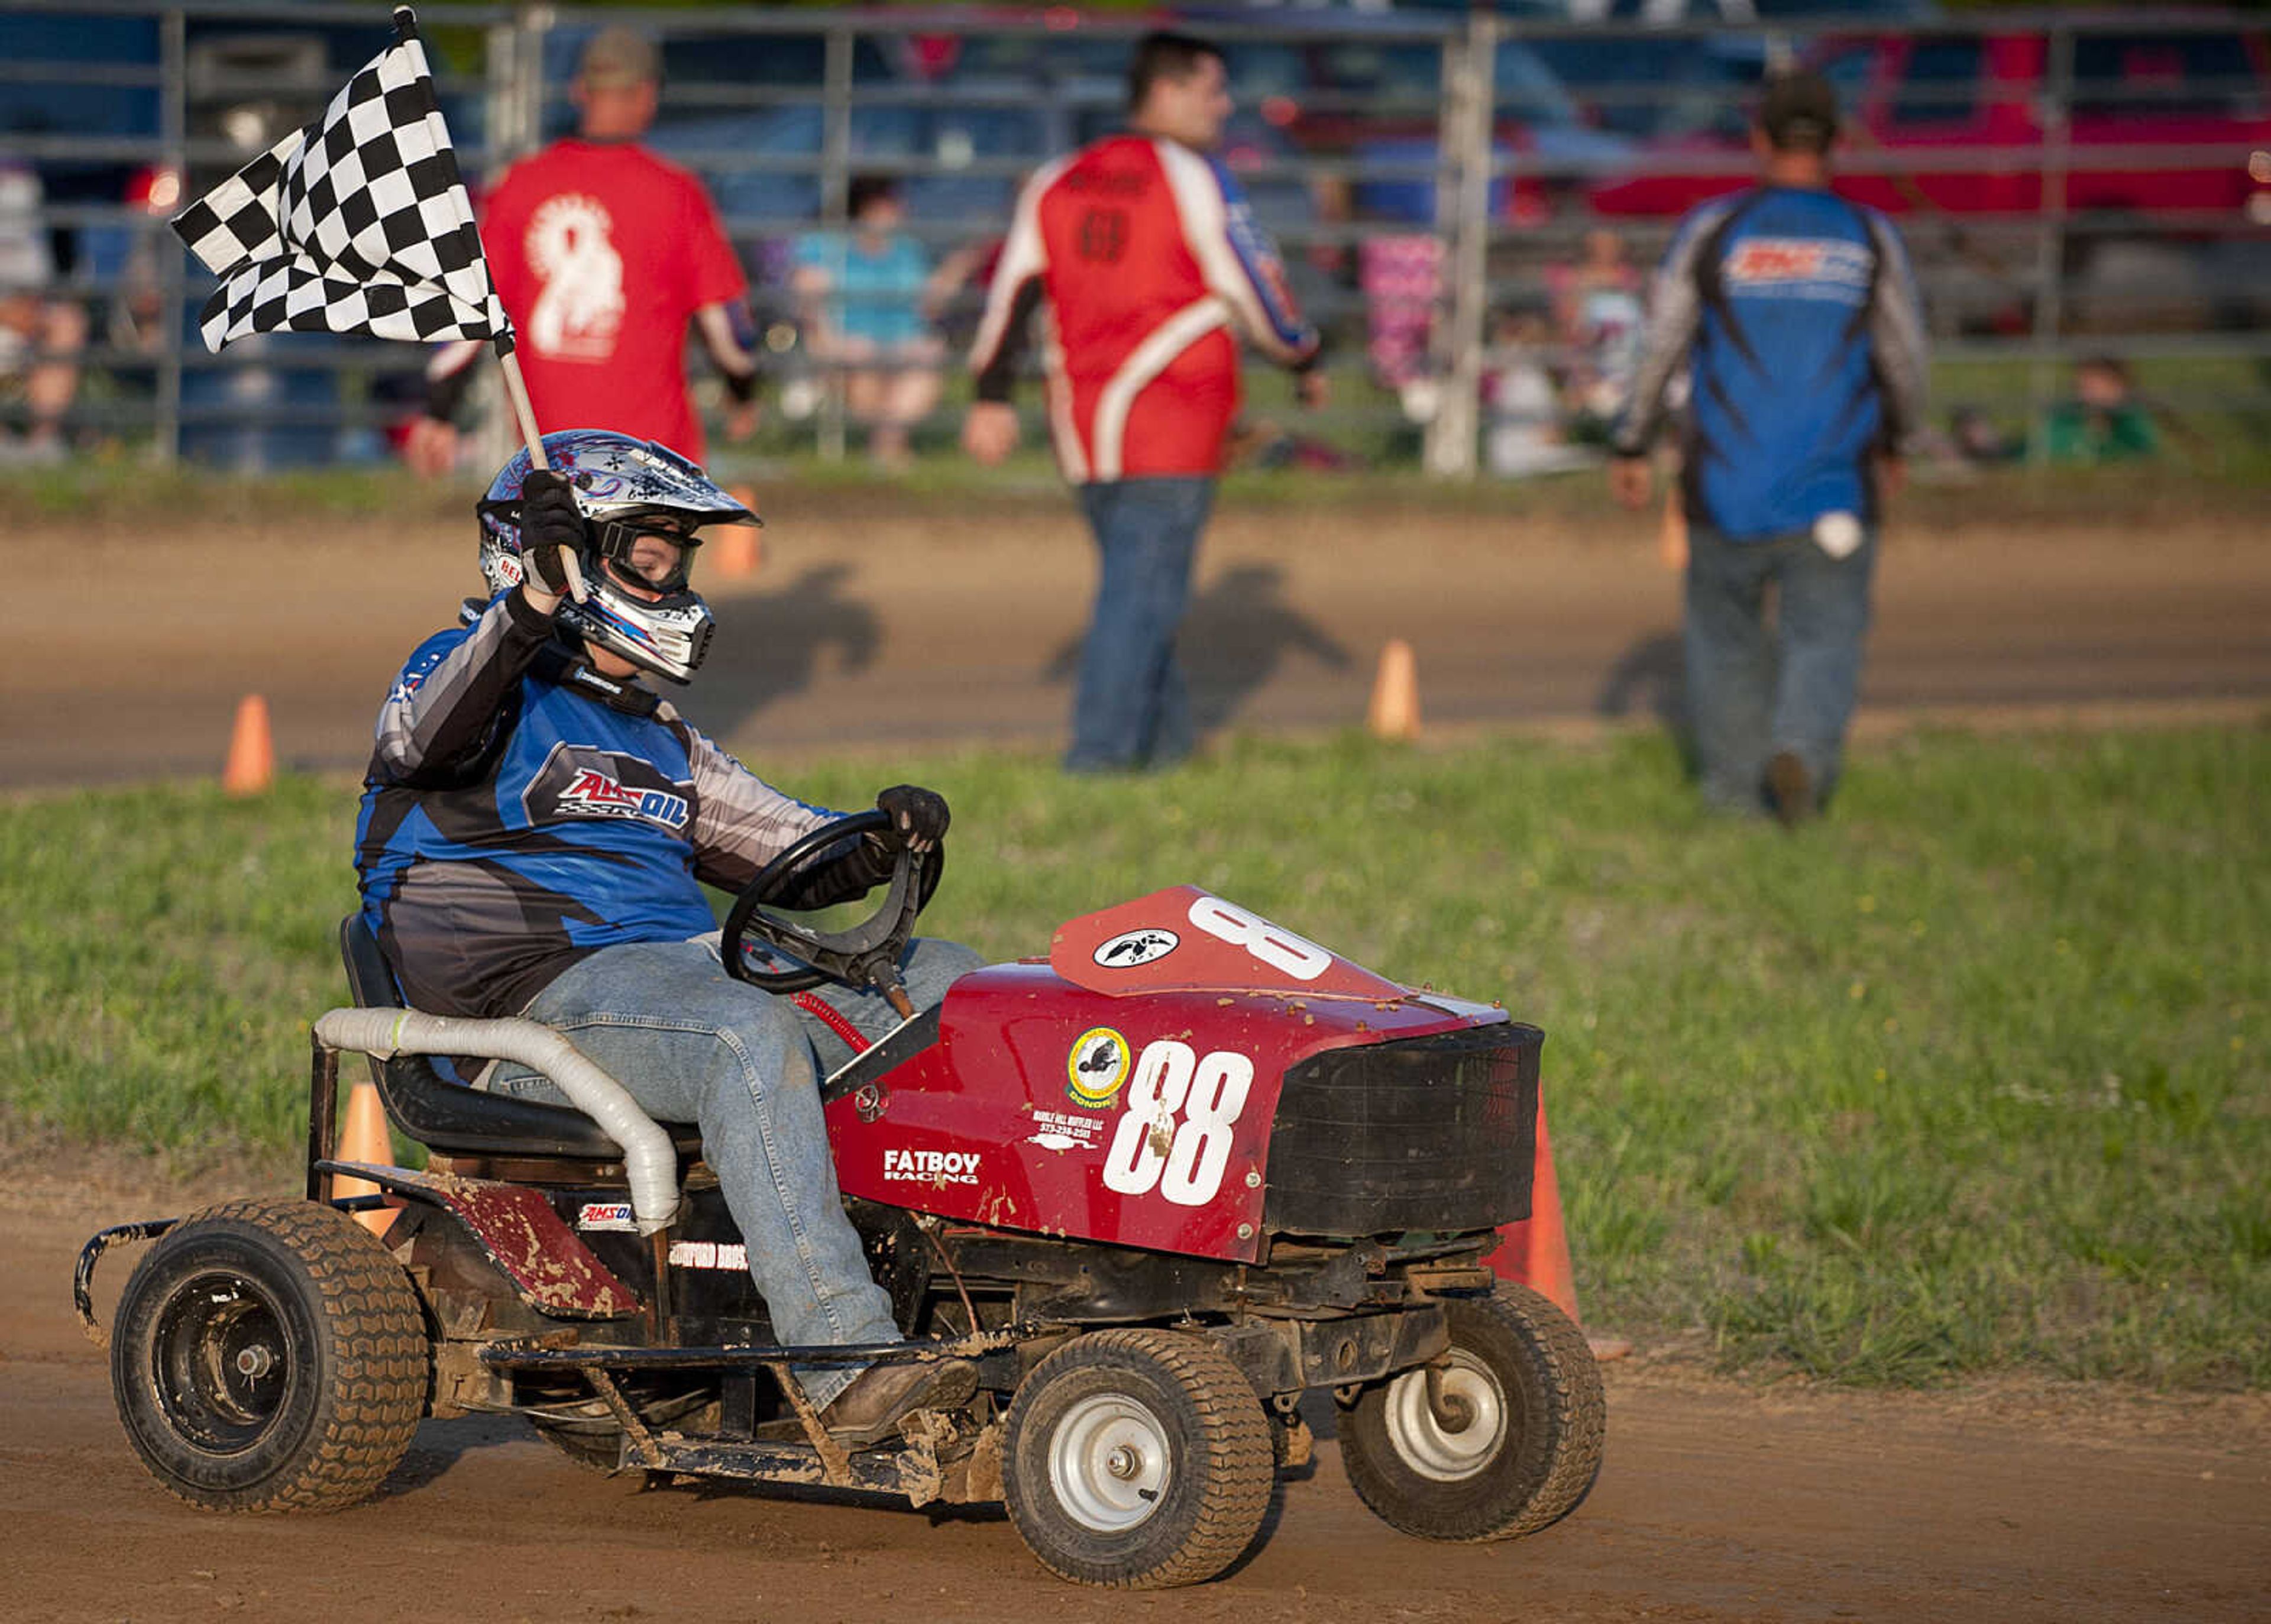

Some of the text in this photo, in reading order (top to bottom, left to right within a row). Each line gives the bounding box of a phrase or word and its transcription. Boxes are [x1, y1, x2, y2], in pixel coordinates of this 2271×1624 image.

[501, 559, 521, 583] BEL
[1102, 1040, 1254, 1206] 88
[884, 1150, 981, 1174] FATBOY
[884, 1172, 978, 1185] RACING
